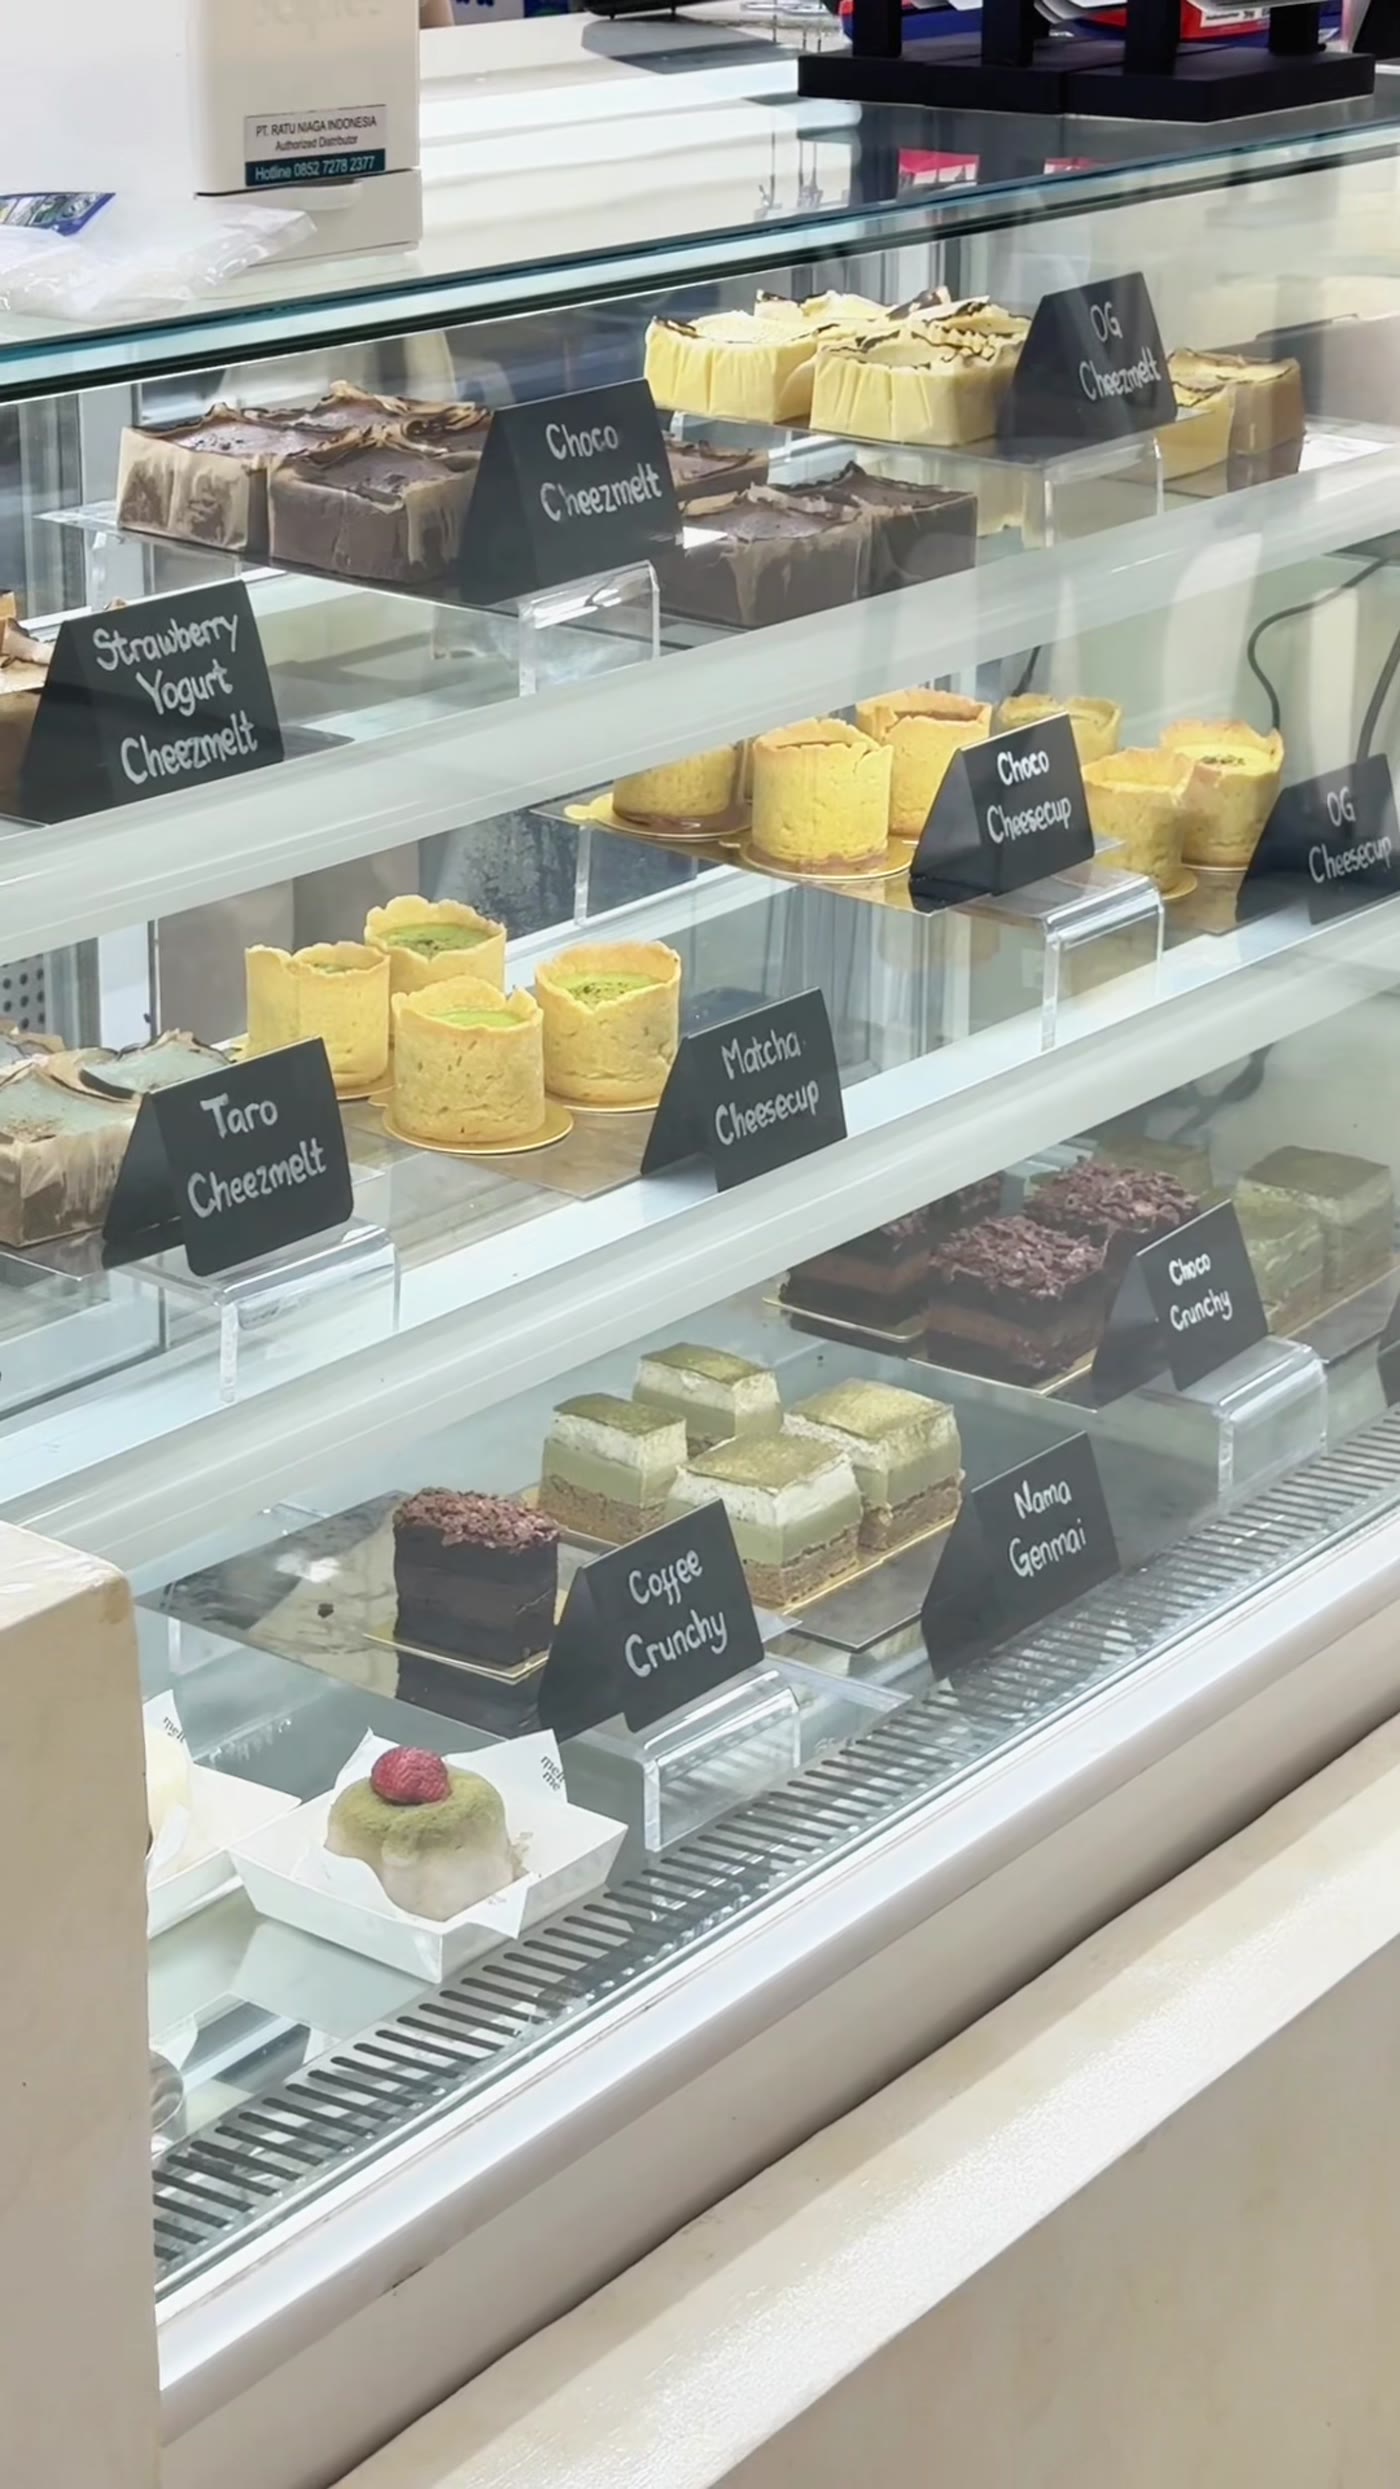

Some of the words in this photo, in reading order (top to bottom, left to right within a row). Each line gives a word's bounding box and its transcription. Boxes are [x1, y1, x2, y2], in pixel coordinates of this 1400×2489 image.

[256, 125, 269, 137] PT.
[271, 123, 296, 136] RATU
[297, 120, 326, 133] NIAGA
[328, 116, 377, 130] INDONESIA
[275, 138, 317, 151] Authorized
[319, 136, 358, 148] Distributor
[255, 165, 291, 181] Hotline
[293, 161, 319, 177] 0852
[322, 158, 347, 174] 7278
[350, 156, 375, 171] 2377
[1090, 301, 1123, 342] OG
[1079, 346, 1161, 401] Cheezmelt
[545, 423, 619, 460] Choco
[540, 462, 663, 522] Cheezmelt
[93, 614, 238, 671] Strawberry
[135, 658, 233, 717] Yogurt
[120, 710, 258, 785] Cheezmelt
[997, 751, 1050, 786] Choco
[987, 797, 1072, 844] Cheesecup
[1326, 786, 1356, 827] OG
[1308, 836, 1393, 884] Cheesecup
[721, 1029, 801, 1080] Matcha
[200, 1093, 278, 1138] Taro
[715, 1080, 819, 1145] Cheesecup
[187, 1137, 327, 1218] Cheezmelt
[1168, 1253, 1211, 1286] Choco
[1170, 1288, 1233, 1331] Crunchy
[1014, 1480, 1073, 1519] Nama
[1009, 1517, 1087, 1577] Genmai
[629, 1550, 703, 1606] Coffee
[625, 1609, 728, 1678] Crunchy
[542, 1771, 561, 1791] me
